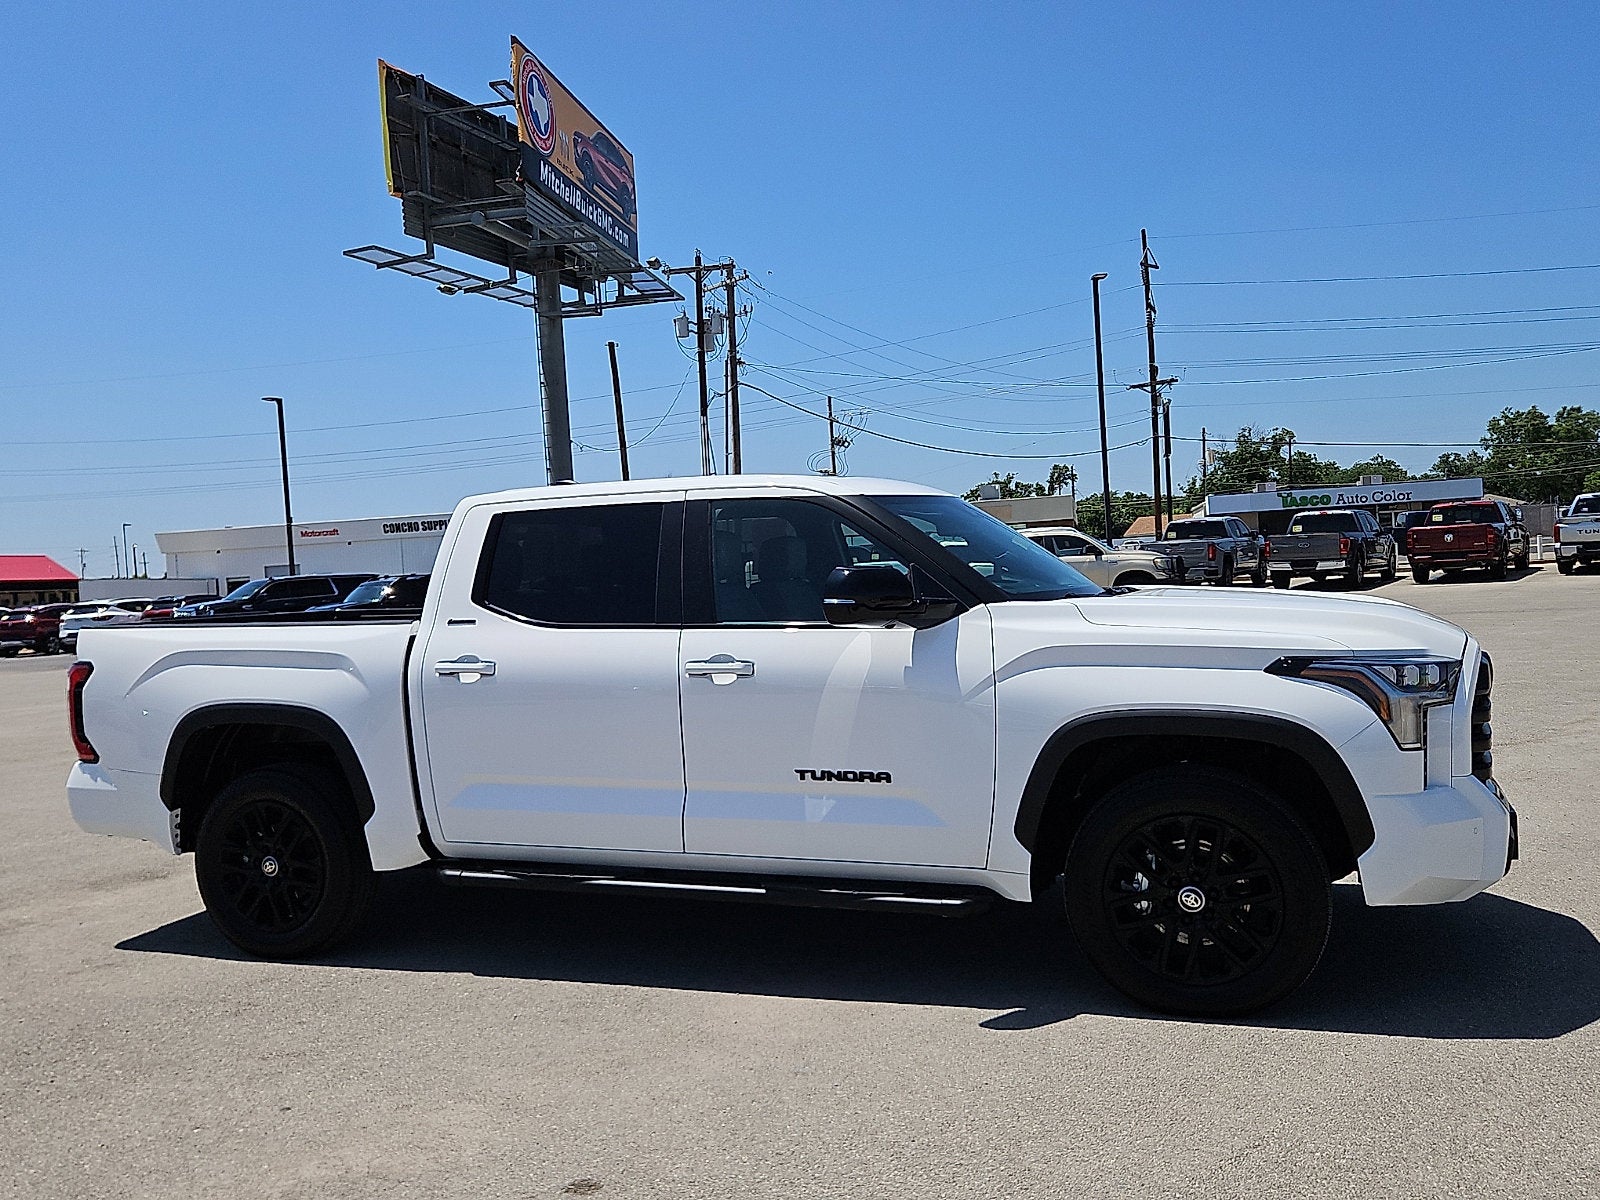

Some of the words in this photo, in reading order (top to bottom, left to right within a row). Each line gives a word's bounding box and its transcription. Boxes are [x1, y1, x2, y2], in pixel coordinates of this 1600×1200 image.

[540, 160, 629, 248] MitchellBuickGMC.com
[1277, 492, 1332, 508] TASCO
[1335, 493, 1368, 505] Auto
[1372, 490, 1413, 502] Color
[300, 529, 340, 537] Motorcraft
[382, 521, 420, 534] CONCHO
[794, 769, 892, 784] TUNDRA
